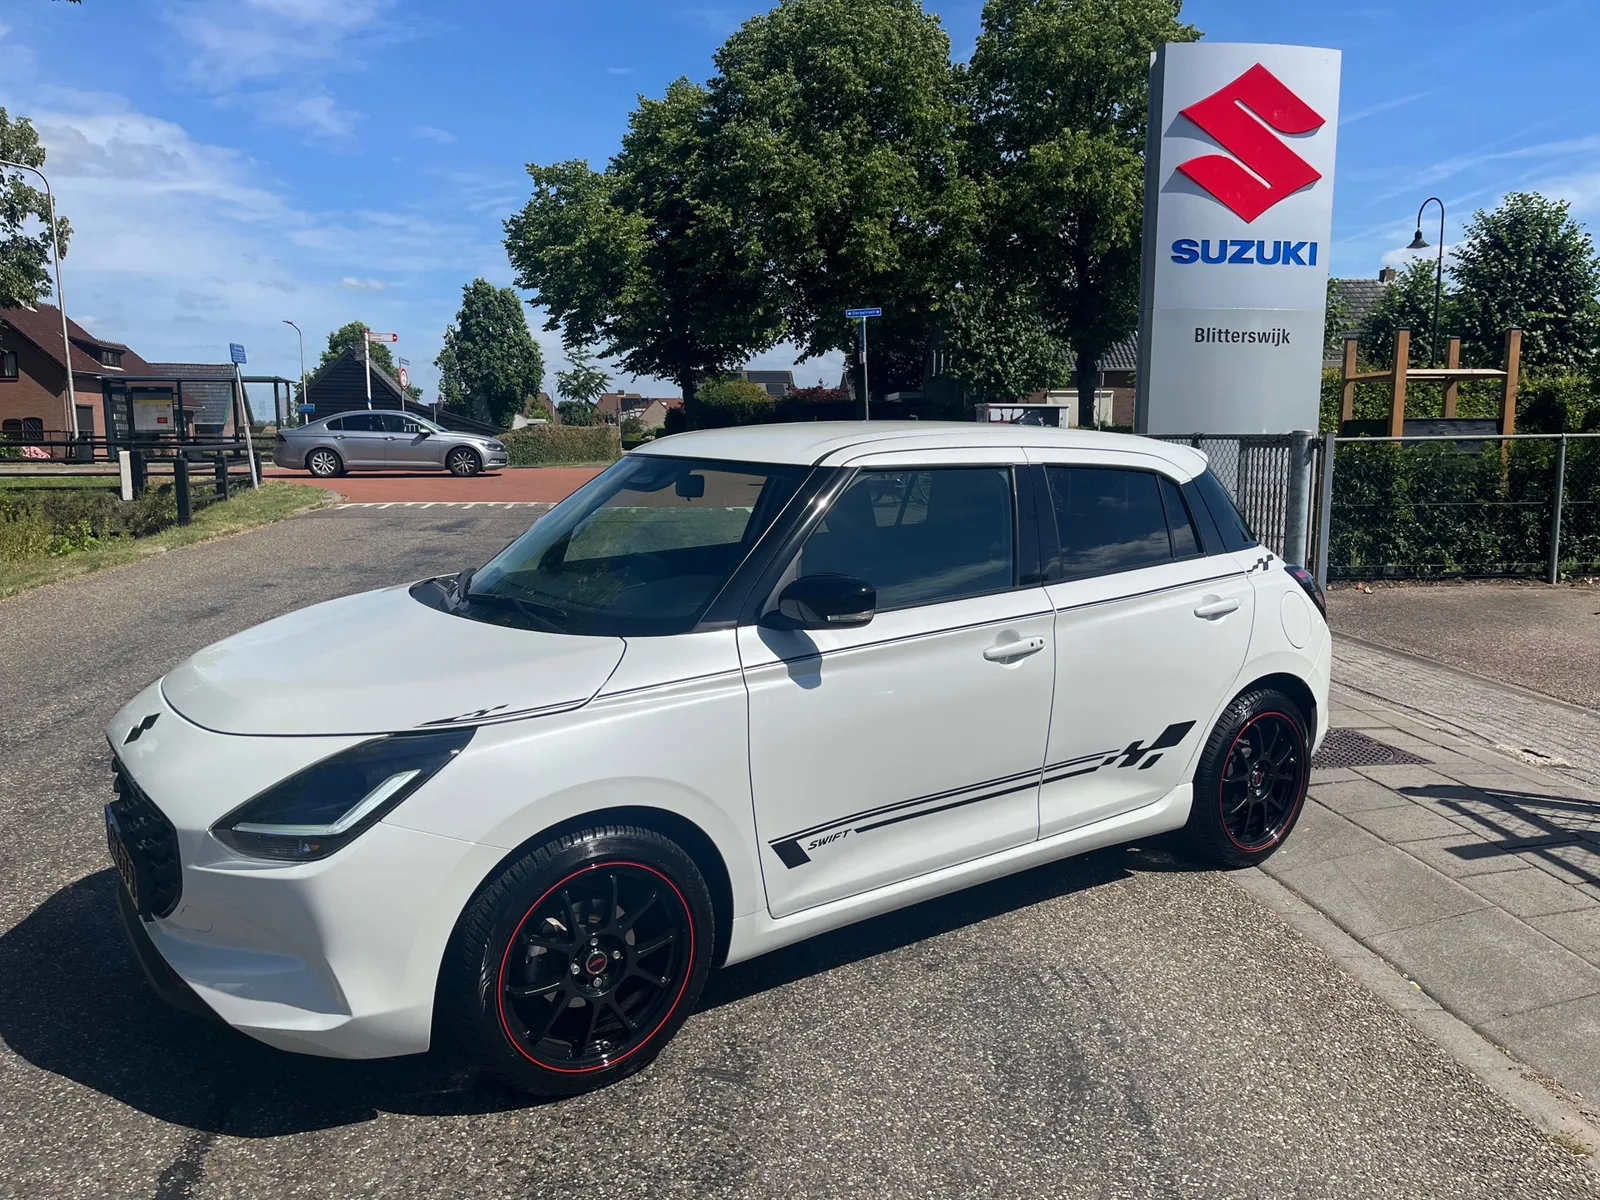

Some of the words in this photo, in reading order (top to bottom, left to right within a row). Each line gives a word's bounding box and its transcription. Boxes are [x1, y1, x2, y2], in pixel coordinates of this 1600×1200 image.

[1171, 238, 1318, 266] SUZUKI
[1194, 327, 1291, 347] Blitterswijk
[807, 828, 853, 851] SWIFT
